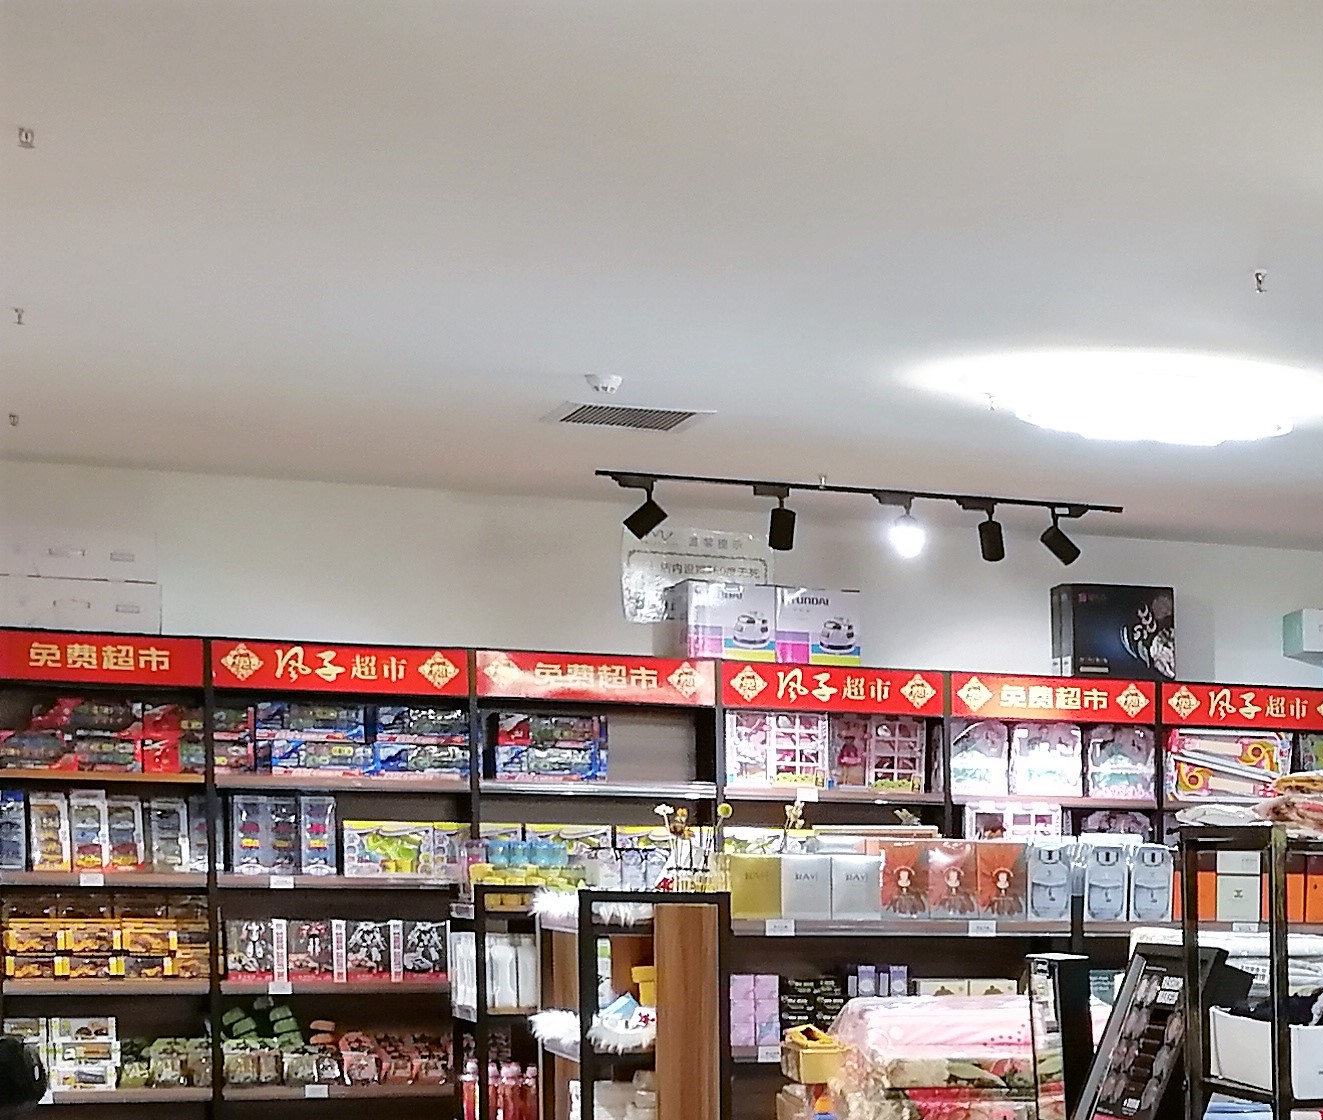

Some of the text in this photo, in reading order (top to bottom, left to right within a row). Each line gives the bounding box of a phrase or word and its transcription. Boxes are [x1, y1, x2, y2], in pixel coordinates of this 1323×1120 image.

[29, 642, 170, 672] 免费超市
[533, 662, 658, 690] 免费超市
[1000, 684, 1108, 712] 免费超市
